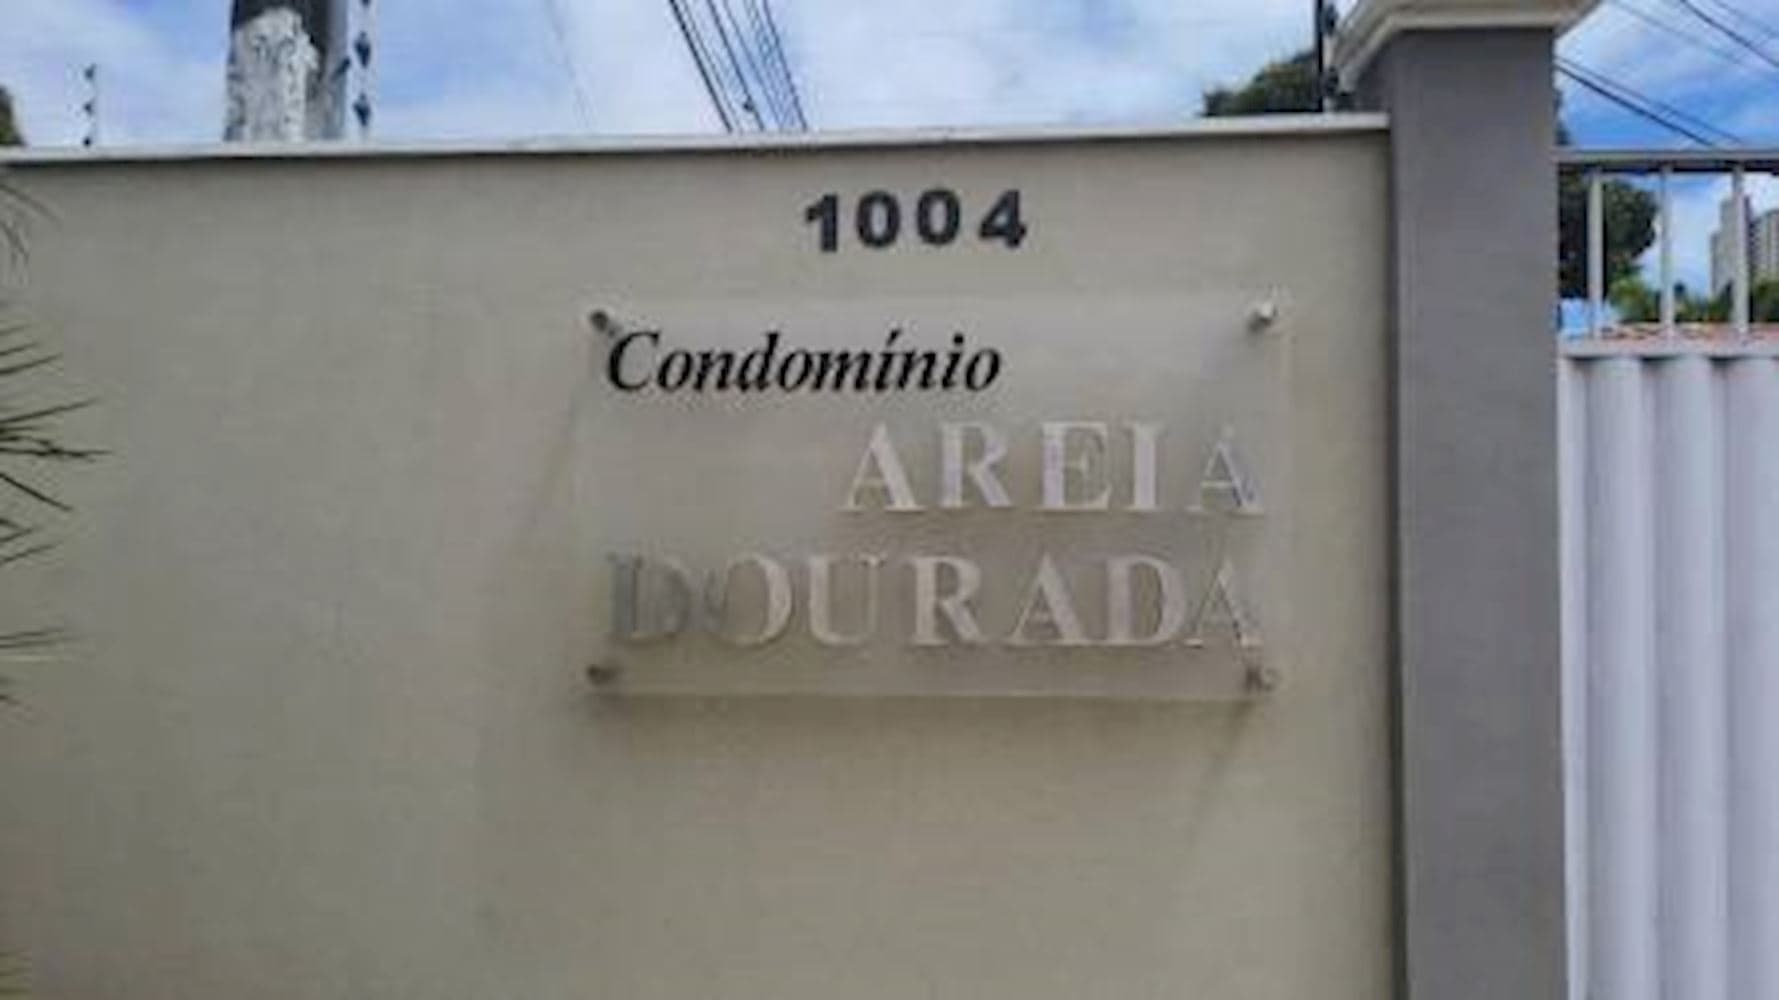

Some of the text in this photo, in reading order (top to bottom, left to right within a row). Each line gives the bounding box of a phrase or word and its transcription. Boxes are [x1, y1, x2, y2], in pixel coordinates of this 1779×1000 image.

[805, 188, 1028, 252] 1004
[607, 328, 1002, 394] Condomínio
[845, 420, 1265, 513] AREIA
[607, 551, 1264, 648] DOURADA
